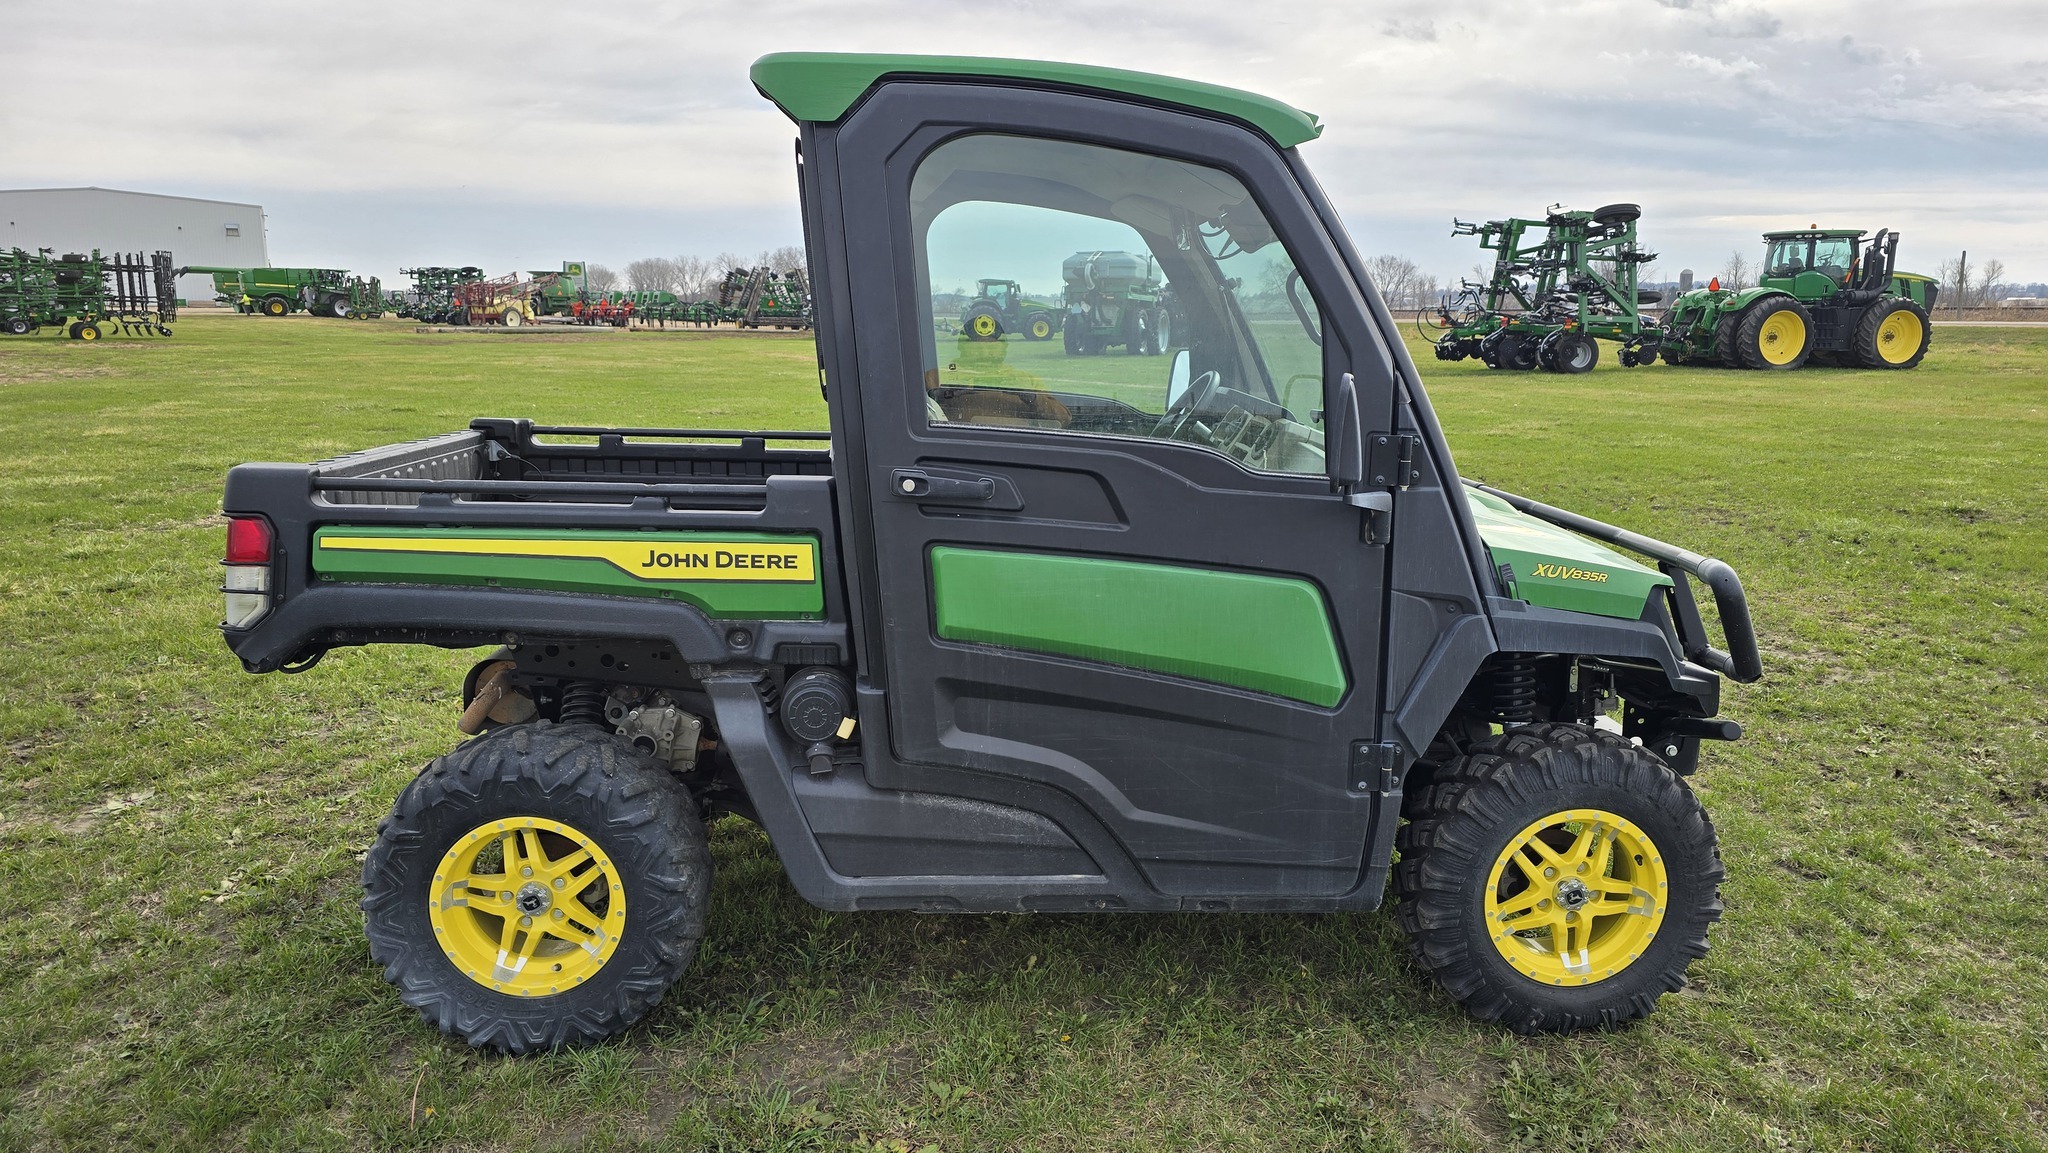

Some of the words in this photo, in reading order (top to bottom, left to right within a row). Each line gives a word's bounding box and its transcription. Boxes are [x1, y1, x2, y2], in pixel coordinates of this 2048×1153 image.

[642, 550, 708, 568] JOHN
[716, 551, 798, 569] DEERE
[415, 943, 498, 1013] BIGHORN
